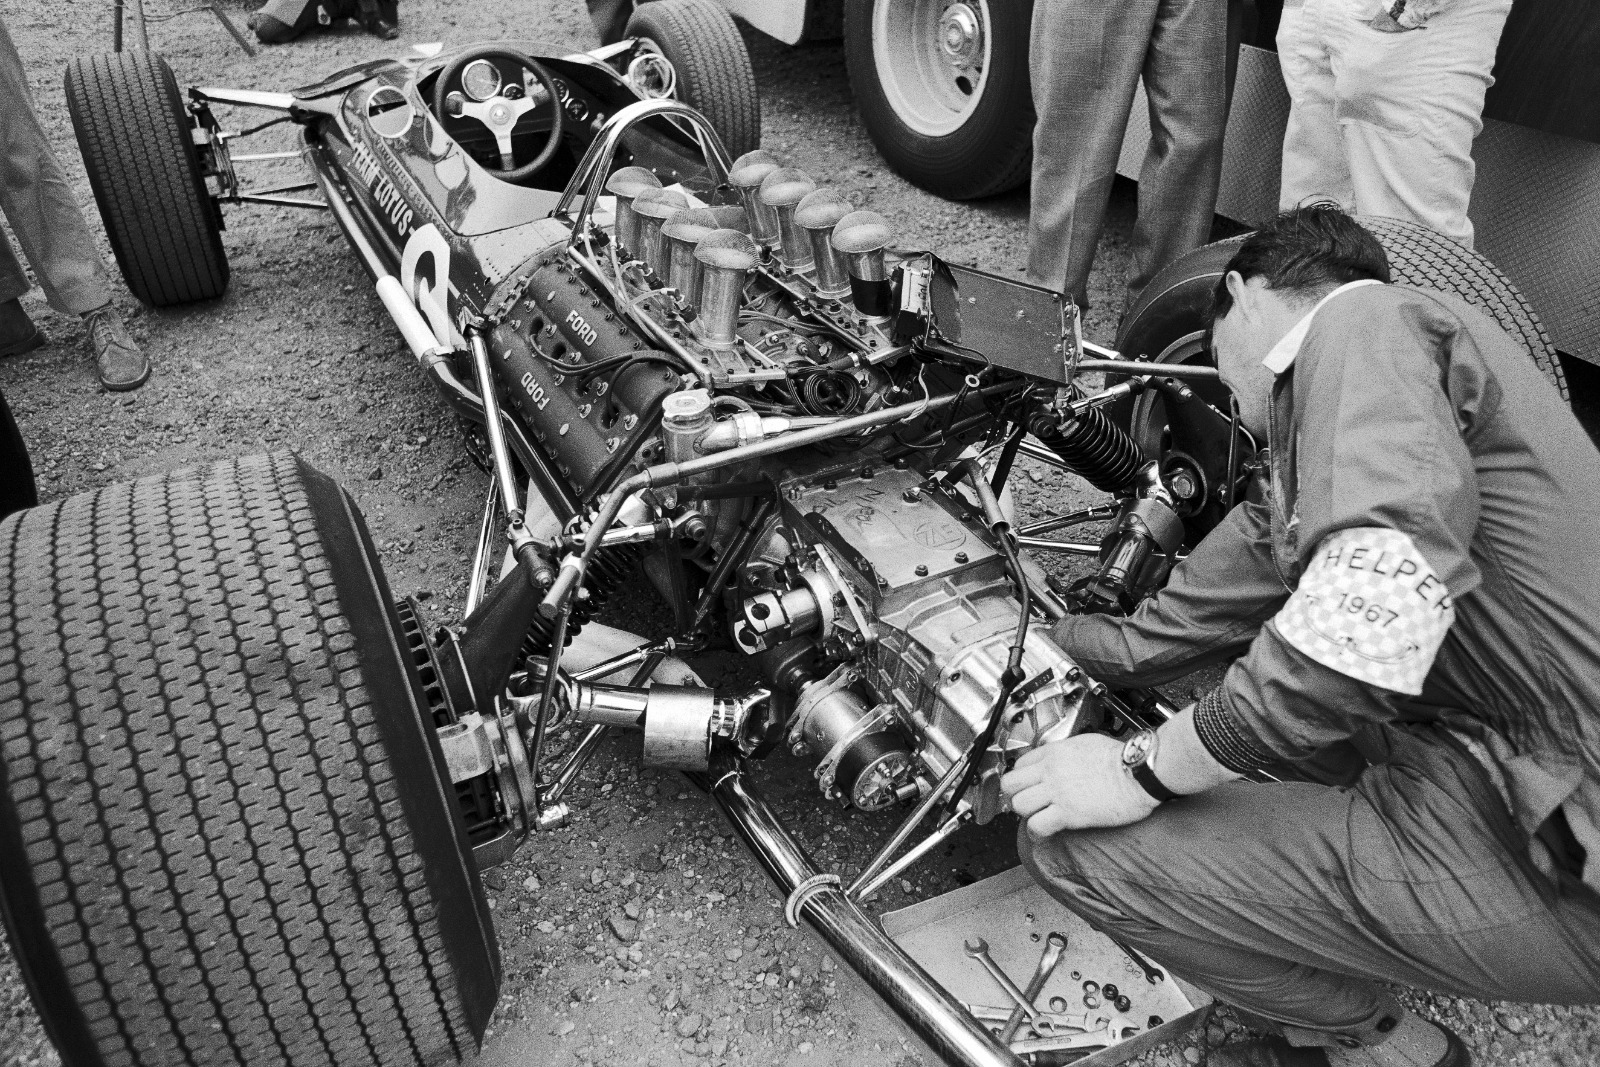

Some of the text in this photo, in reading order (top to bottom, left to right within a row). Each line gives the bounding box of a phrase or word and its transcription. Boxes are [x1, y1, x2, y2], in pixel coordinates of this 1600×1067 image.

[352, 141, 413, 236] TEAM LOTUS
[565, 309, 598, 346] FORD
[520, 371, 551, 411] FORD
[1323, 547, 1452, 619] HELPER
[1338, 592, 1399, 628] 1967
